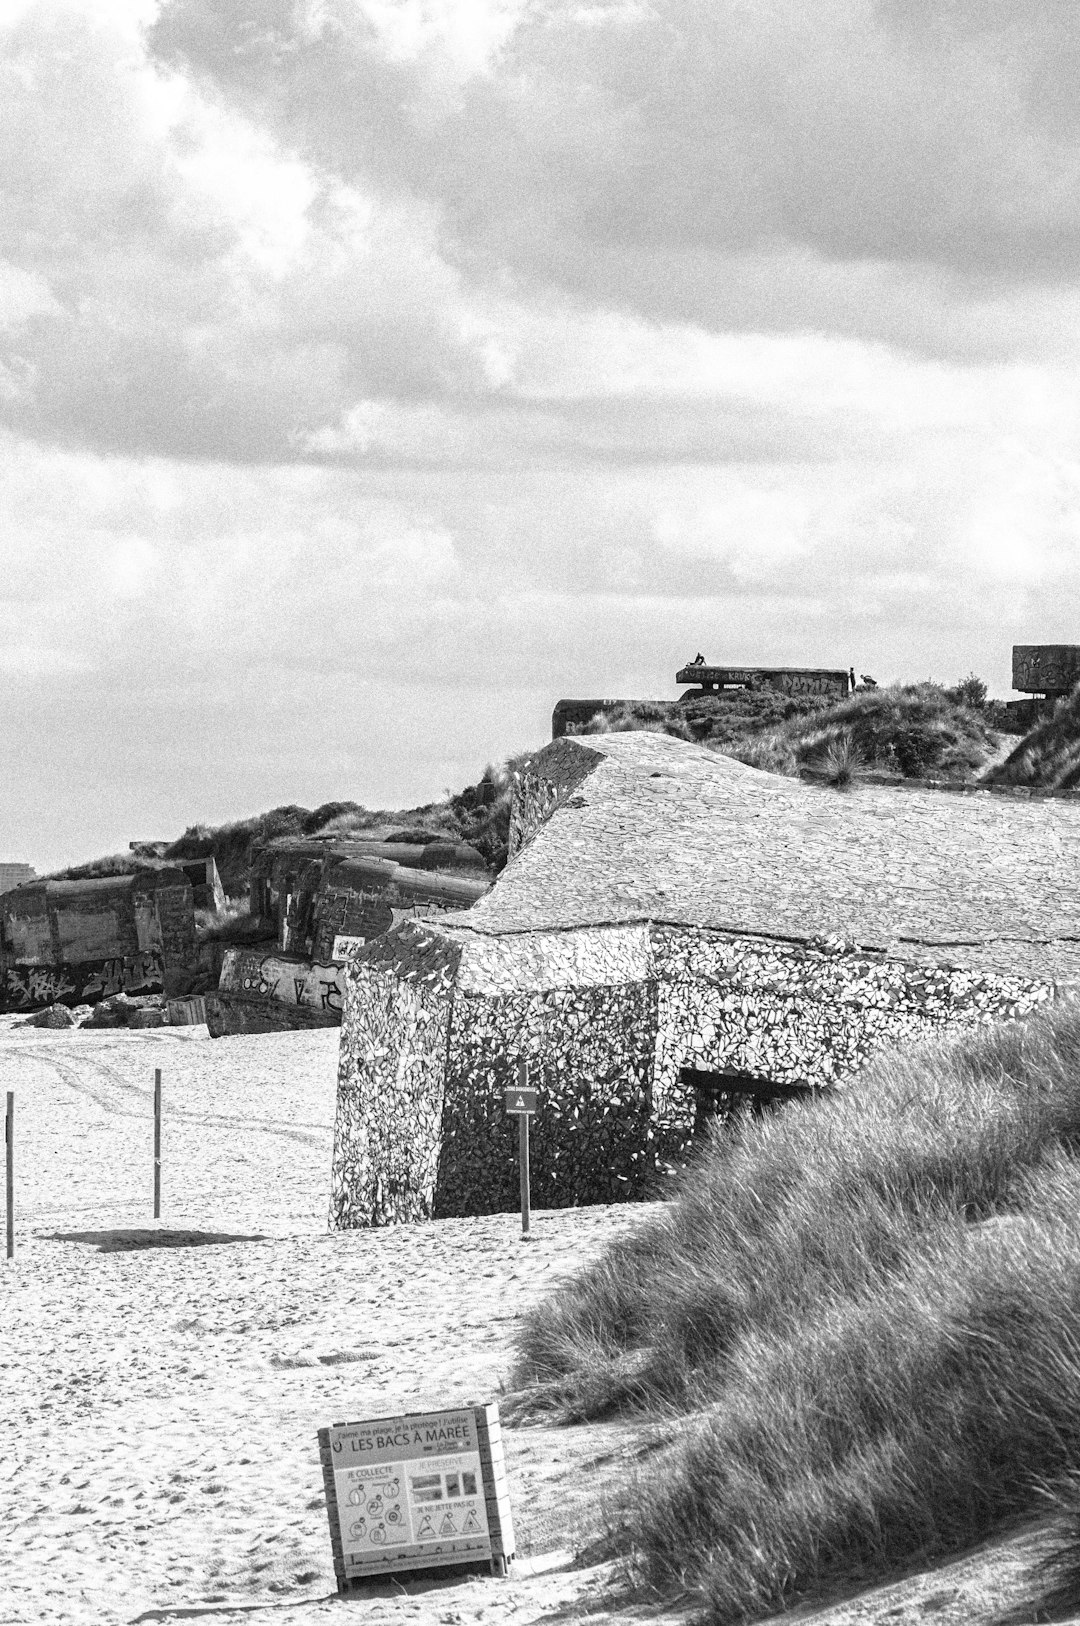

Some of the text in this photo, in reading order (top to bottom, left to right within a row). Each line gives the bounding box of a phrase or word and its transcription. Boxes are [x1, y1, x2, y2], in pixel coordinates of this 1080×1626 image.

[360, 1429, 371, 1437] ma
[395, 1425, 402, 1434] je
[352, 1425, 471, 1452] LES BACS À MARÉE
[419, 1461, 425, 1469] JE
[356, 1466, 394, 1478] COLLECTE
[417, 1500, 475, 1514] JE NE JETTE PAS ICI
